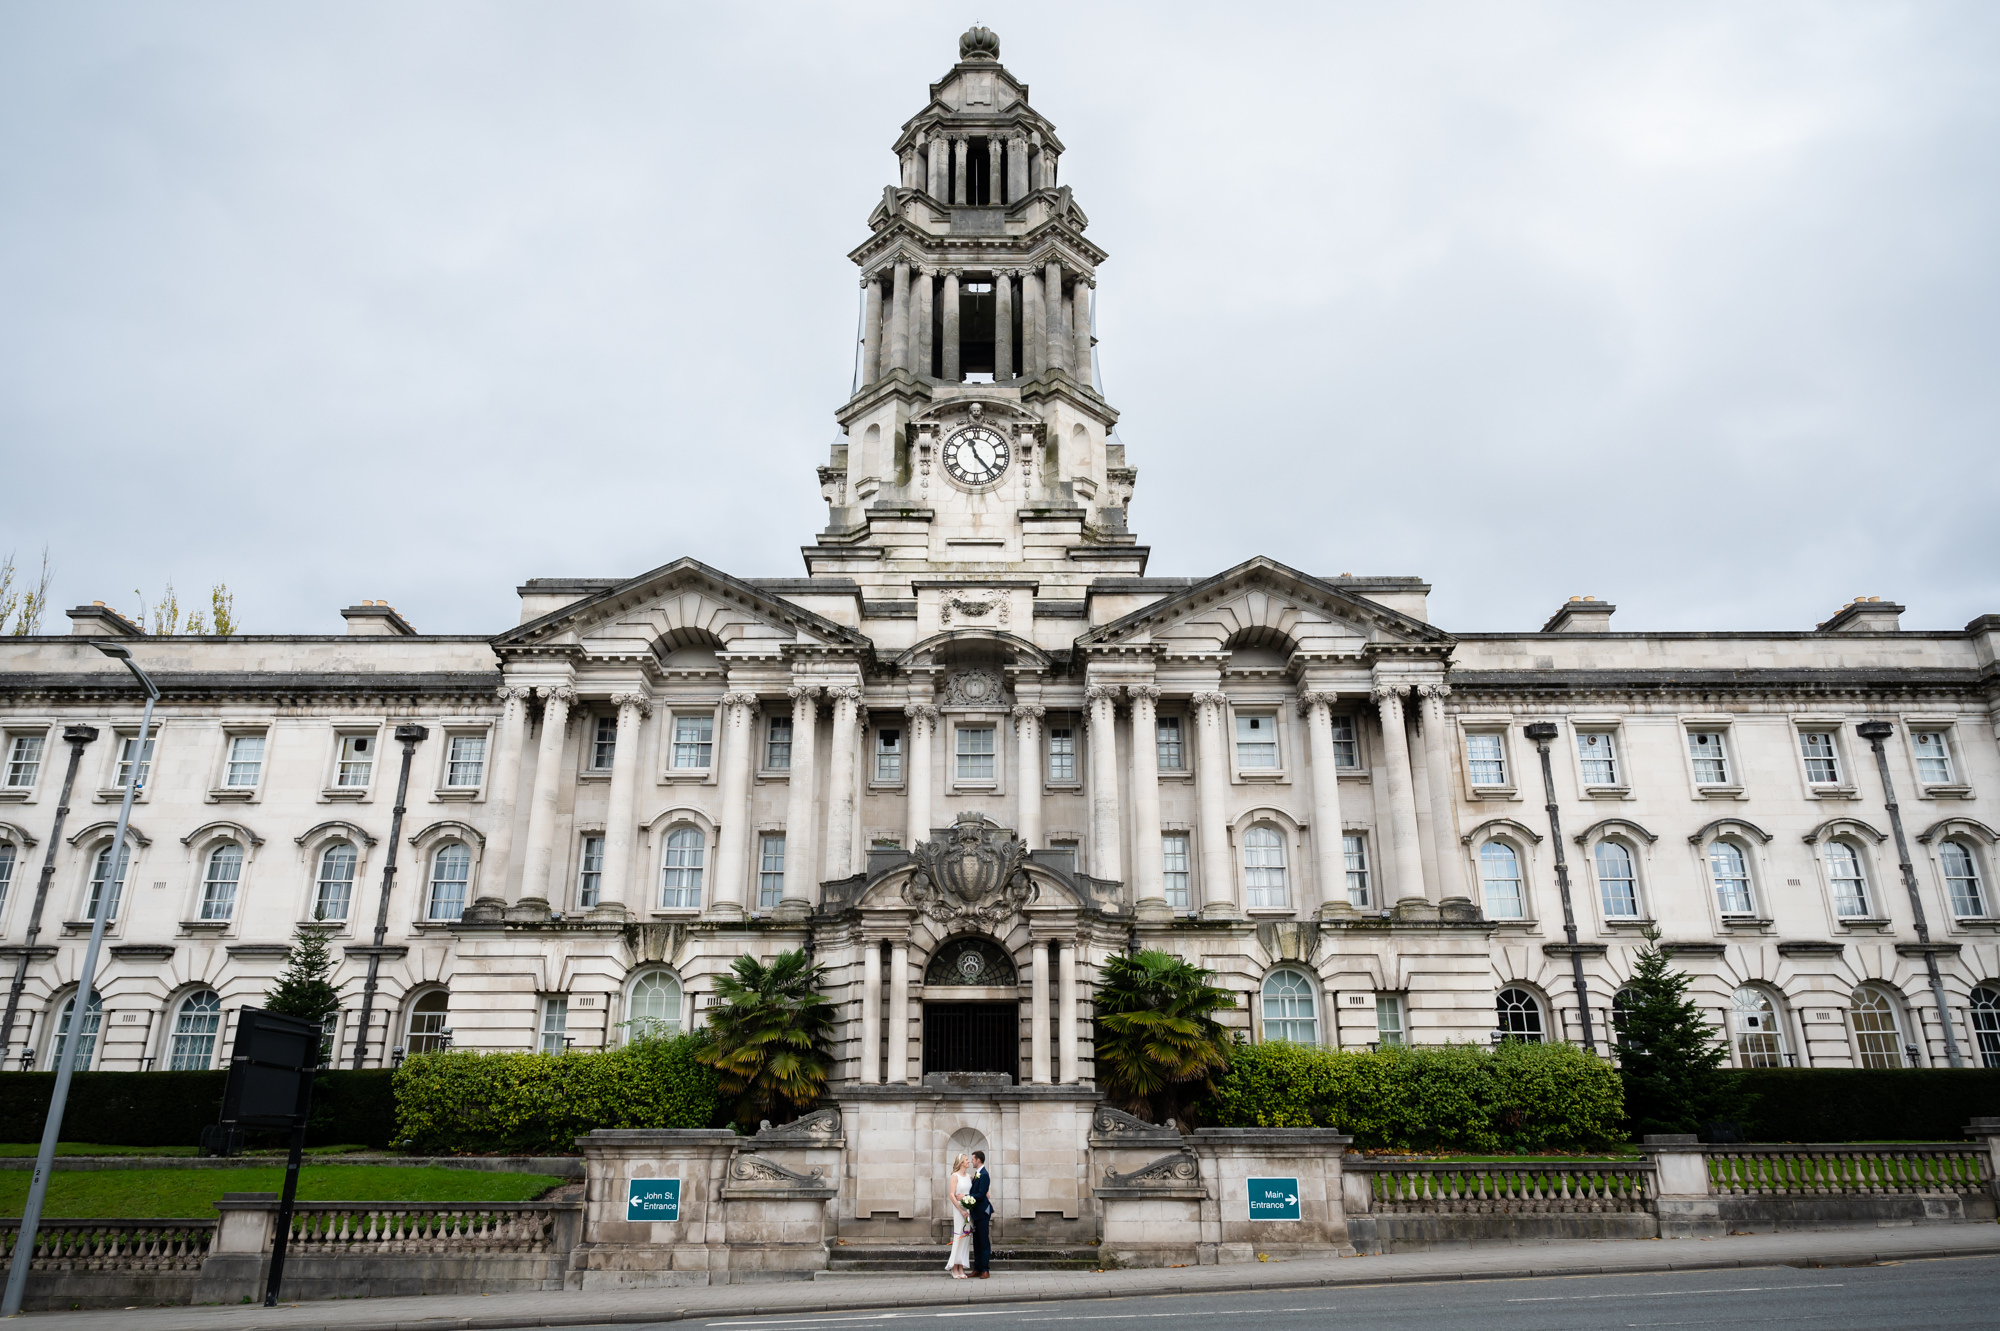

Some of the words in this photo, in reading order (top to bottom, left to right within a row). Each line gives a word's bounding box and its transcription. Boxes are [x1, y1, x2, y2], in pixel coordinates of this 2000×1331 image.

[664, 1191, 674, 1199] St.
[643, 1202, 677, 1210] Entrance
[1251, 1201, 1284, 1209] Entrance
